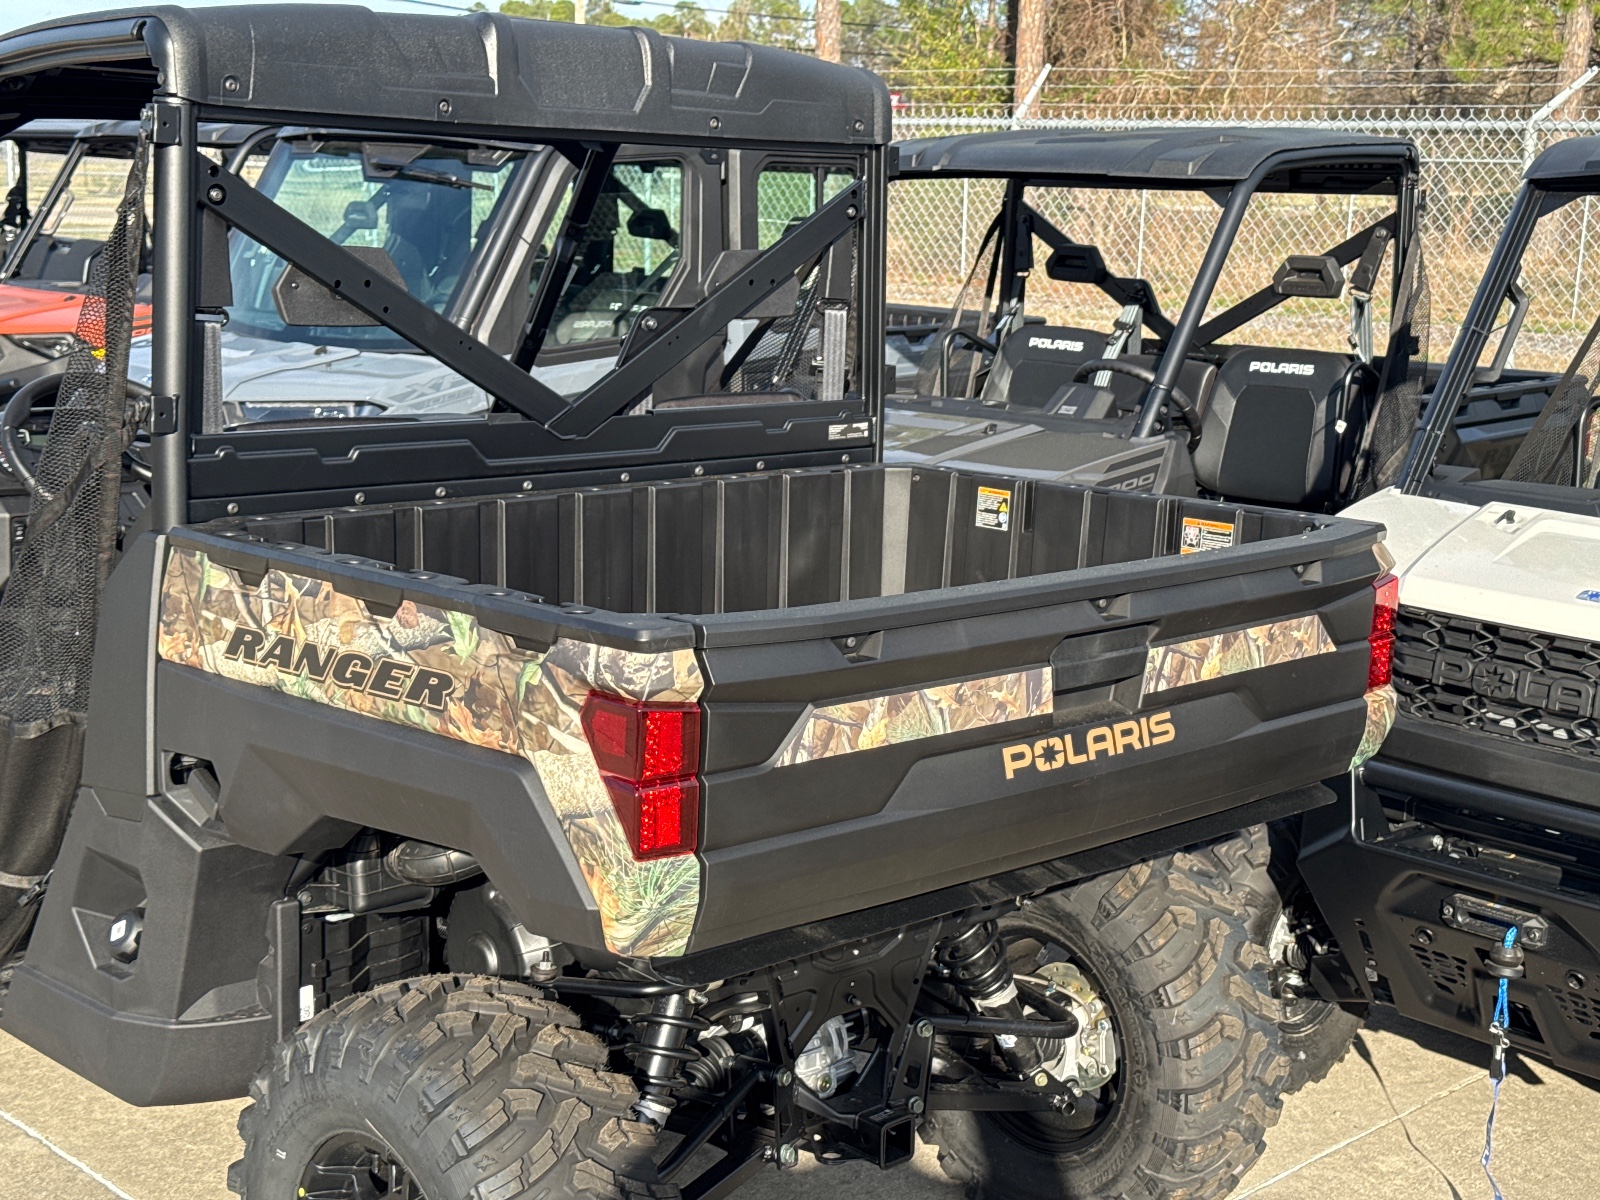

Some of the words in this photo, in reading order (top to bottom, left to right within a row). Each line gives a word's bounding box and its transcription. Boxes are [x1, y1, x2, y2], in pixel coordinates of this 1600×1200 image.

[1028, 337, 1084, 352] POLARIS
[1249, 361, 1315, 376] POLARIS
[223, 624, 455, 711] RANGER
[1431, 650, 1600, 722] POLA
[1002, 711, 1176, 780] POLARIS
